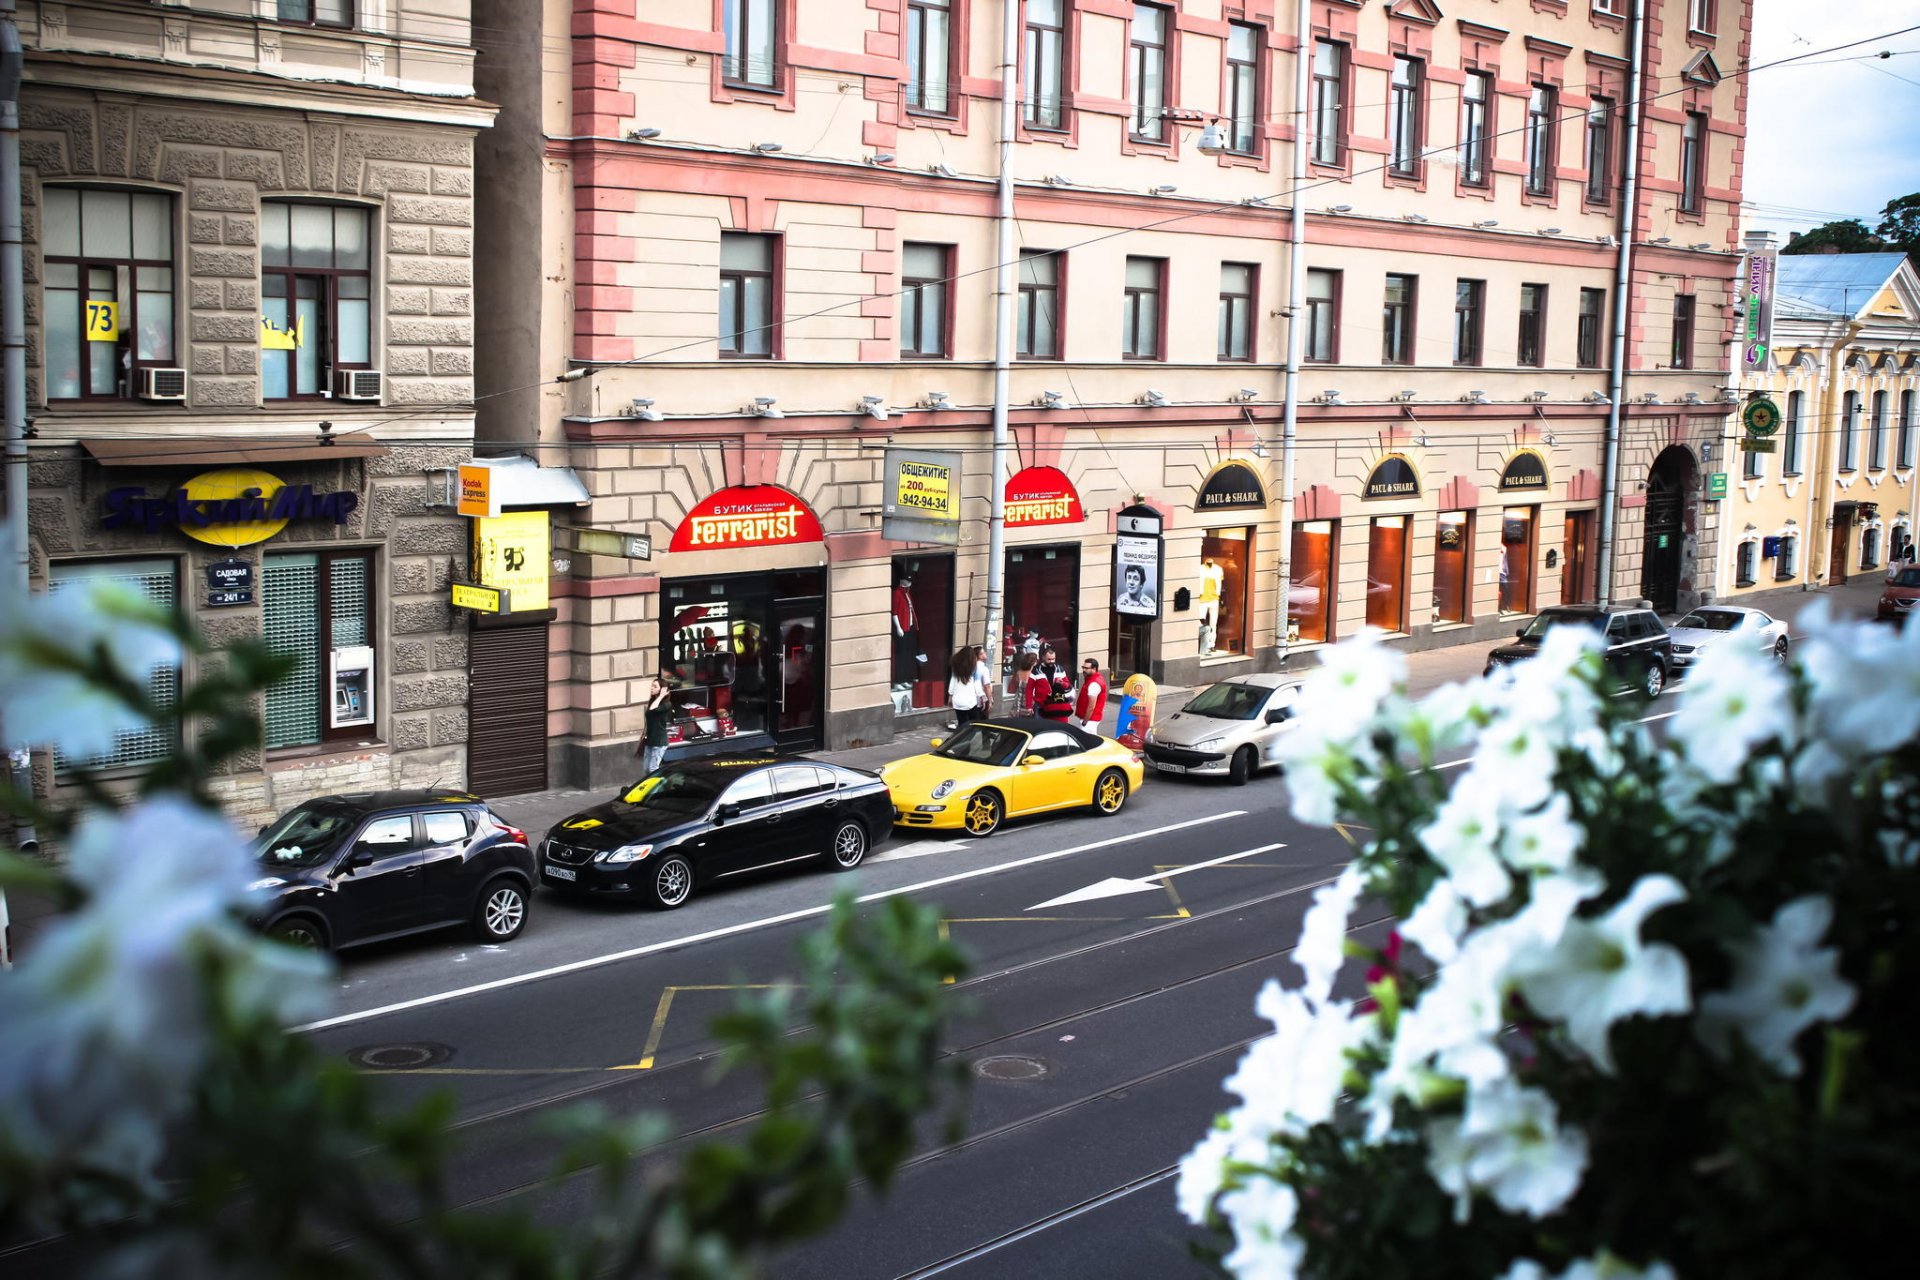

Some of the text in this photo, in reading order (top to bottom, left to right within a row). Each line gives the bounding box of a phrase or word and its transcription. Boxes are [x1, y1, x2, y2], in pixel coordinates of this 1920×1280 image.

[88, 305, 112, 332] 73
[901, 464, 948, 479] ОБЩЕЖИТИЕ
[462, 478, 482, 489] Kodak
[906, 480, 924, 491] 200
[1505, 476, 1519, 485] PAUL
[1524, 475, 1543, 484] SHARK
[462, 488, 486, 498] Express
[1371, 482, 1415, 493] PAUL & SHARK
[1013, 492, 1040, 500] БУТИК
[1205, 492, 1258, 504] PAUL & SHARK
[267, 483, 359, 525] Мир
[714, 504, 753, 515] БУТИК
[690, 504, 804, 545] Ferrarist
[215, 569, 247, 578] САДОВАЯ
[224, 593, 238, 602] 24/1
